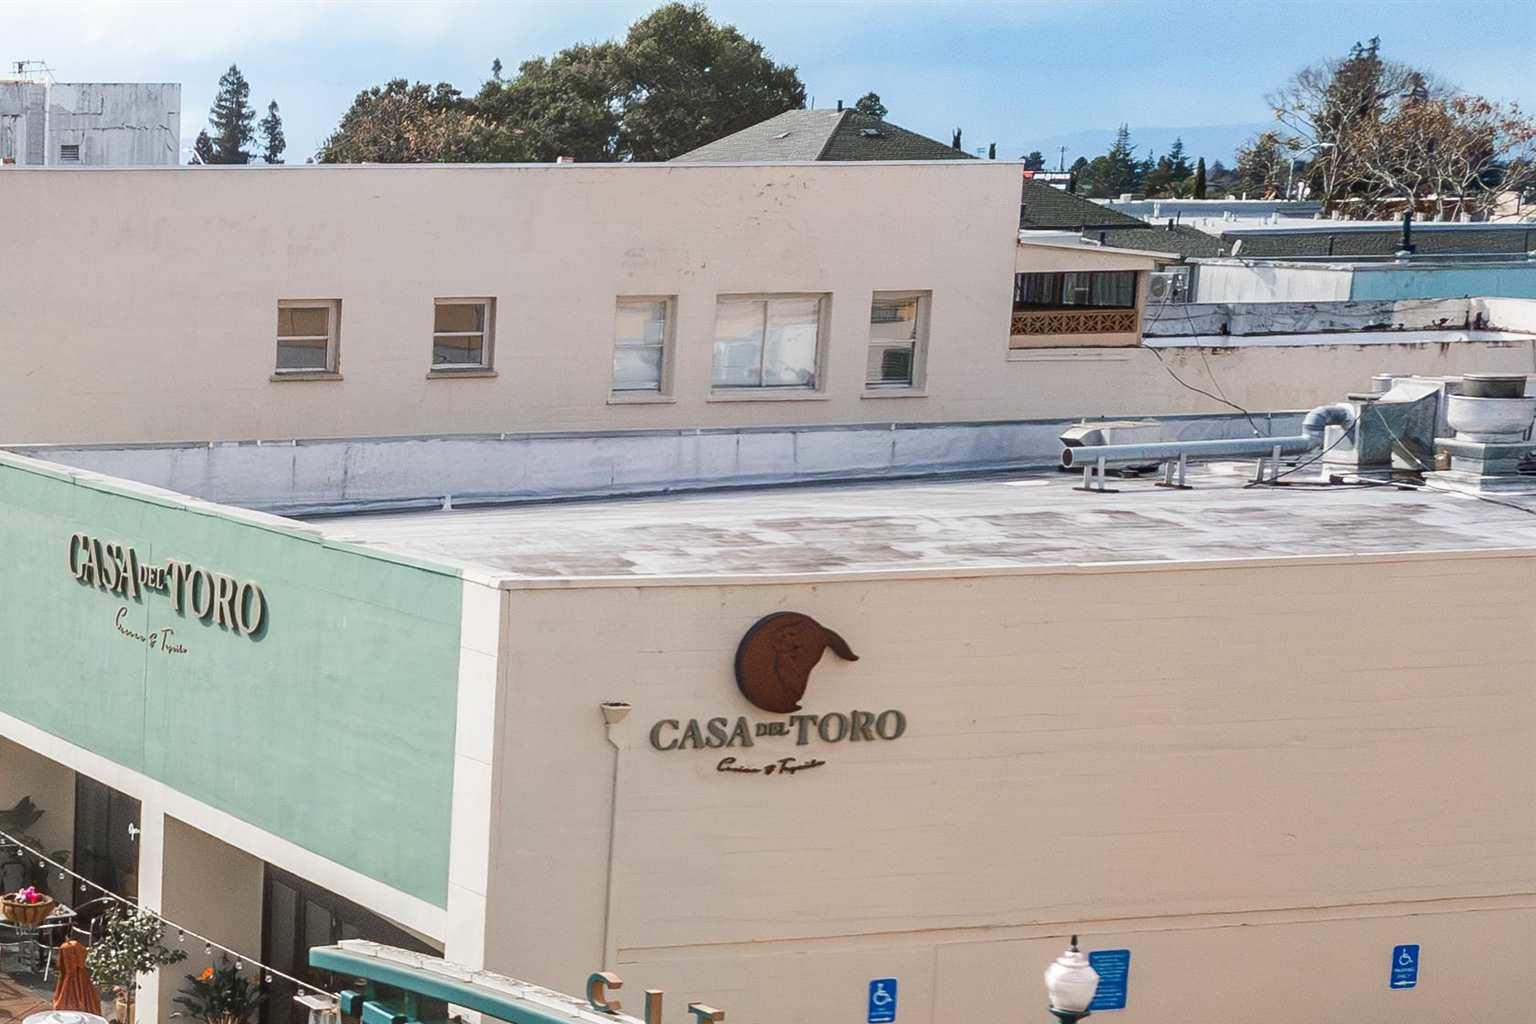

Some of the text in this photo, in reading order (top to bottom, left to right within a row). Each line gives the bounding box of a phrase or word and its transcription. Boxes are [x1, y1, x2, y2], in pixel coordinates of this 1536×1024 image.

[68, 533, 267, 637] CASA DEL TORO
[649, 709, 907, 751] CASA DEL TORO
